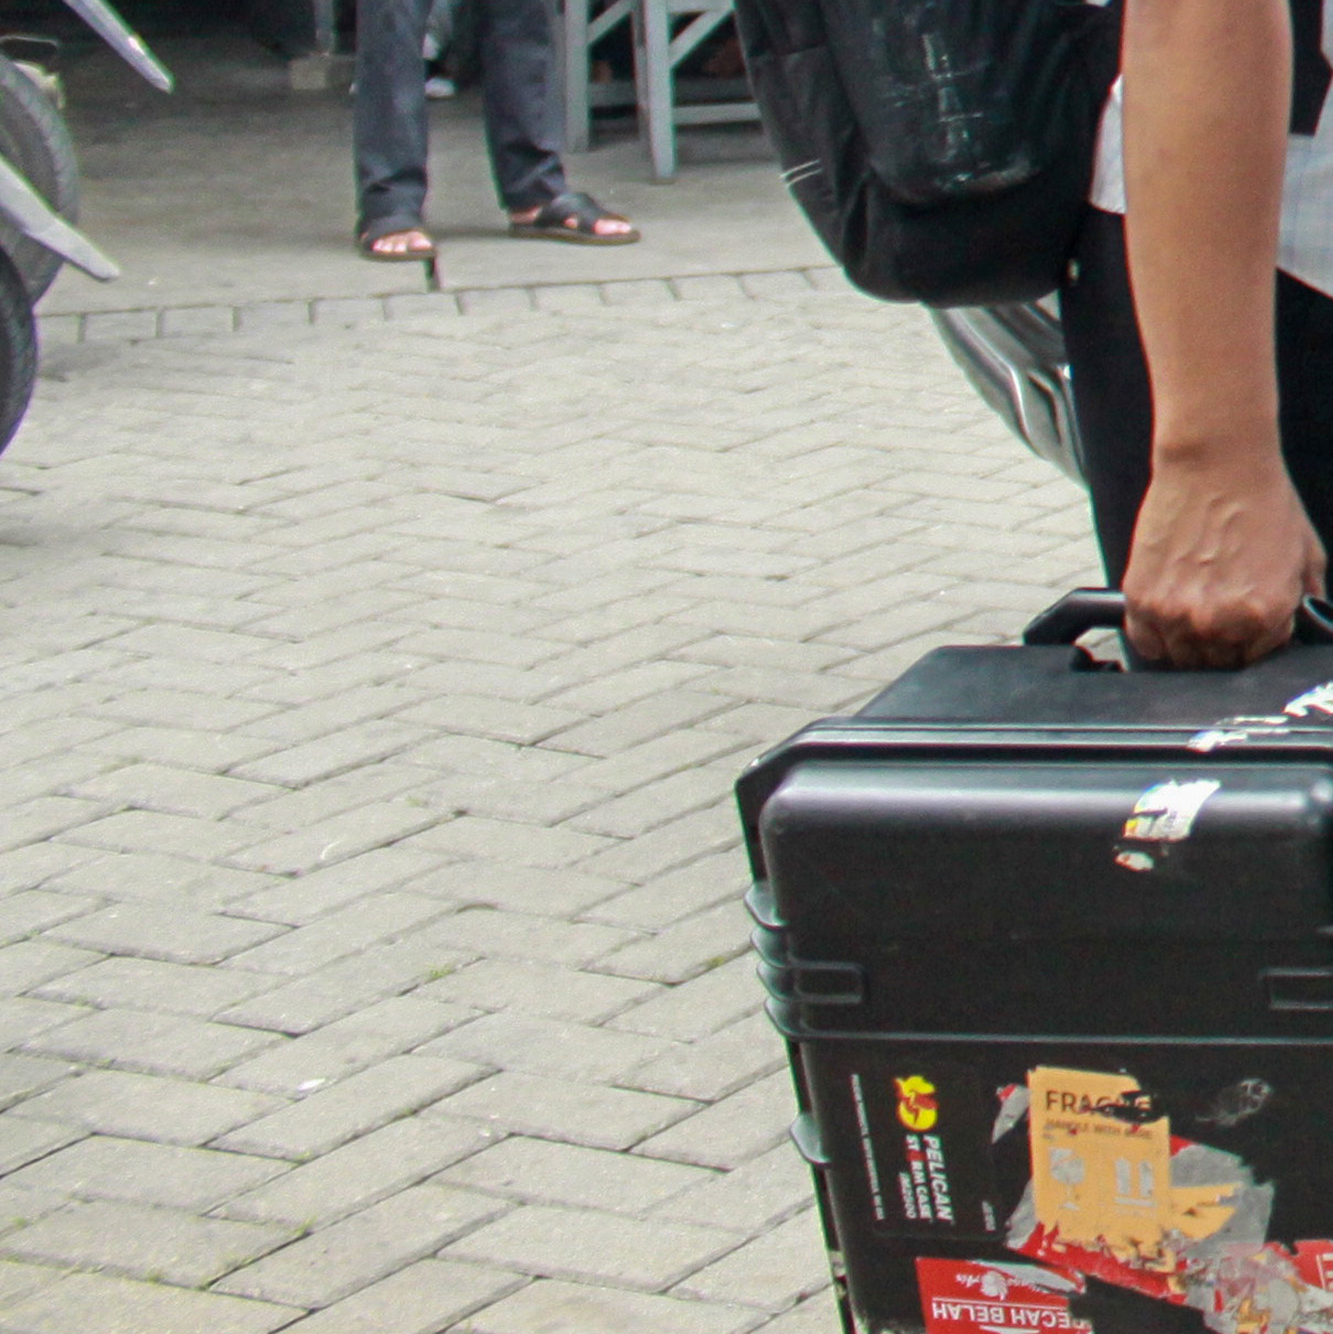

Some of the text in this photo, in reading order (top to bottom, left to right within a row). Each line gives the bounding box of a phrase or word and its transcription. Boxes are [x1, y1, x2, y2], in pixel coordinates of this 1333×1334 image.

[923, 1134, 954, 1220] PELICAN
[916, 1185, 933, 1219] CASE
[932, 1301, 1005, 1324] BELAH
